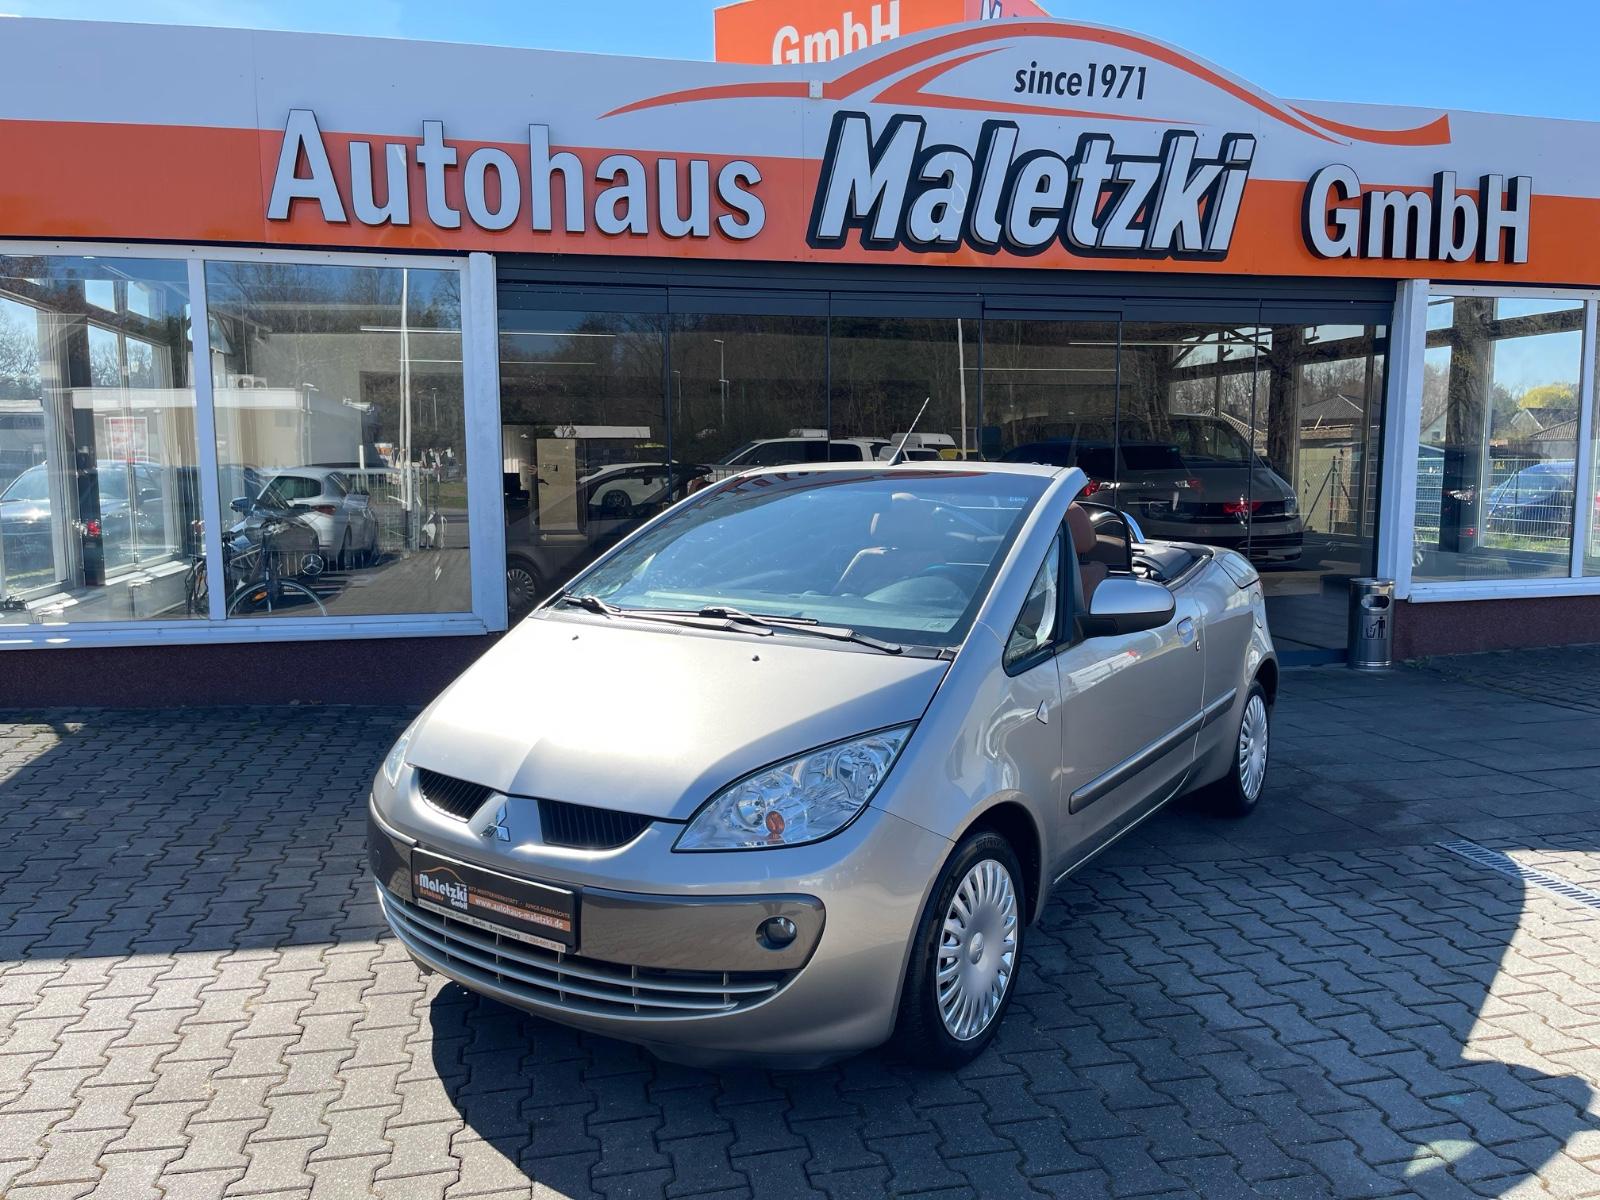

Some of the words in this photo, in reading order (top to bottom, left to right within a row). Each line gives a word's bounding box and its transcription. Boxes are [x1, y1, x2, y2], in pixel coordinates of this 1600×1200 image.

[772, 1, 899, 65] GmbH
[267, 108, 766, 240] Autohaus
[807, 111, 1256, 261] Maletzki
[1301, 163, 1533, 264] GmbH
[419, 873, 468, 902] Maletzki
[474, 898, 564, 930] www.autohaus-maletzki.de
